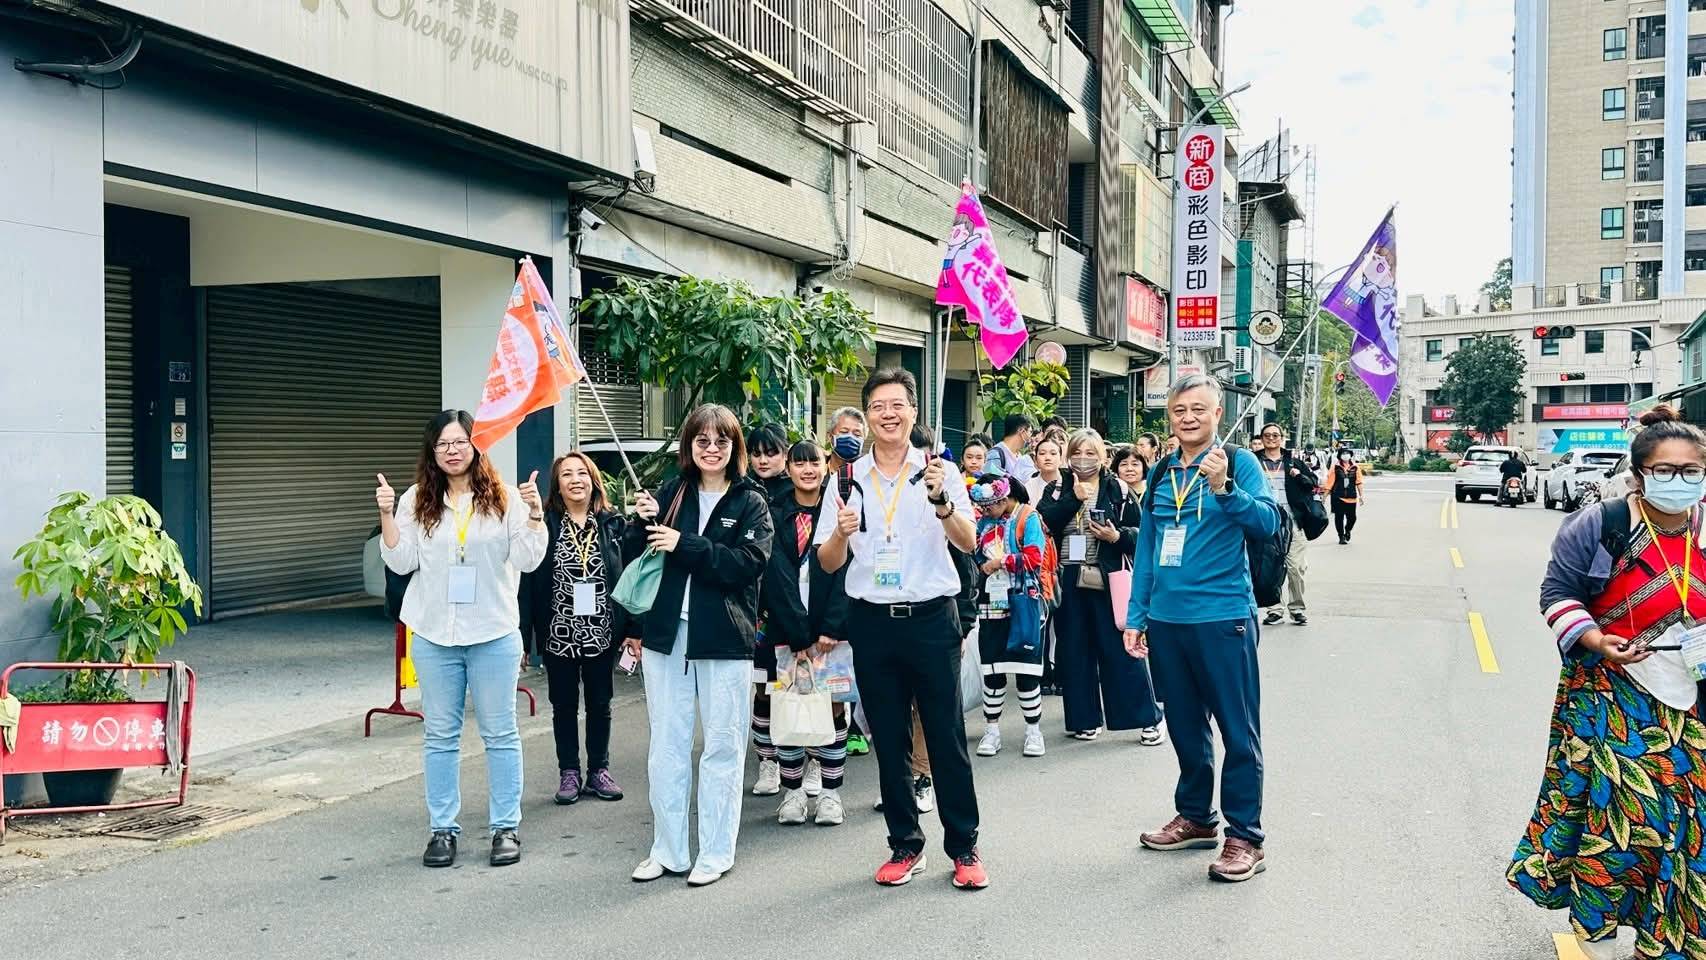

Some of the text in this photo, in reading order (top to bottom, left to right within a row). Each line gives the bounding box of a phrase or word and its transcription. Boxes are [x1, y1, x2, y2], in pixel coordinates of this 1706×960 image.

[1189, 138, 1211, 187] 新商
[1186, 194, 1208, 290] 彩色影印
[42, 717, 166, 745] 請勿 停車
